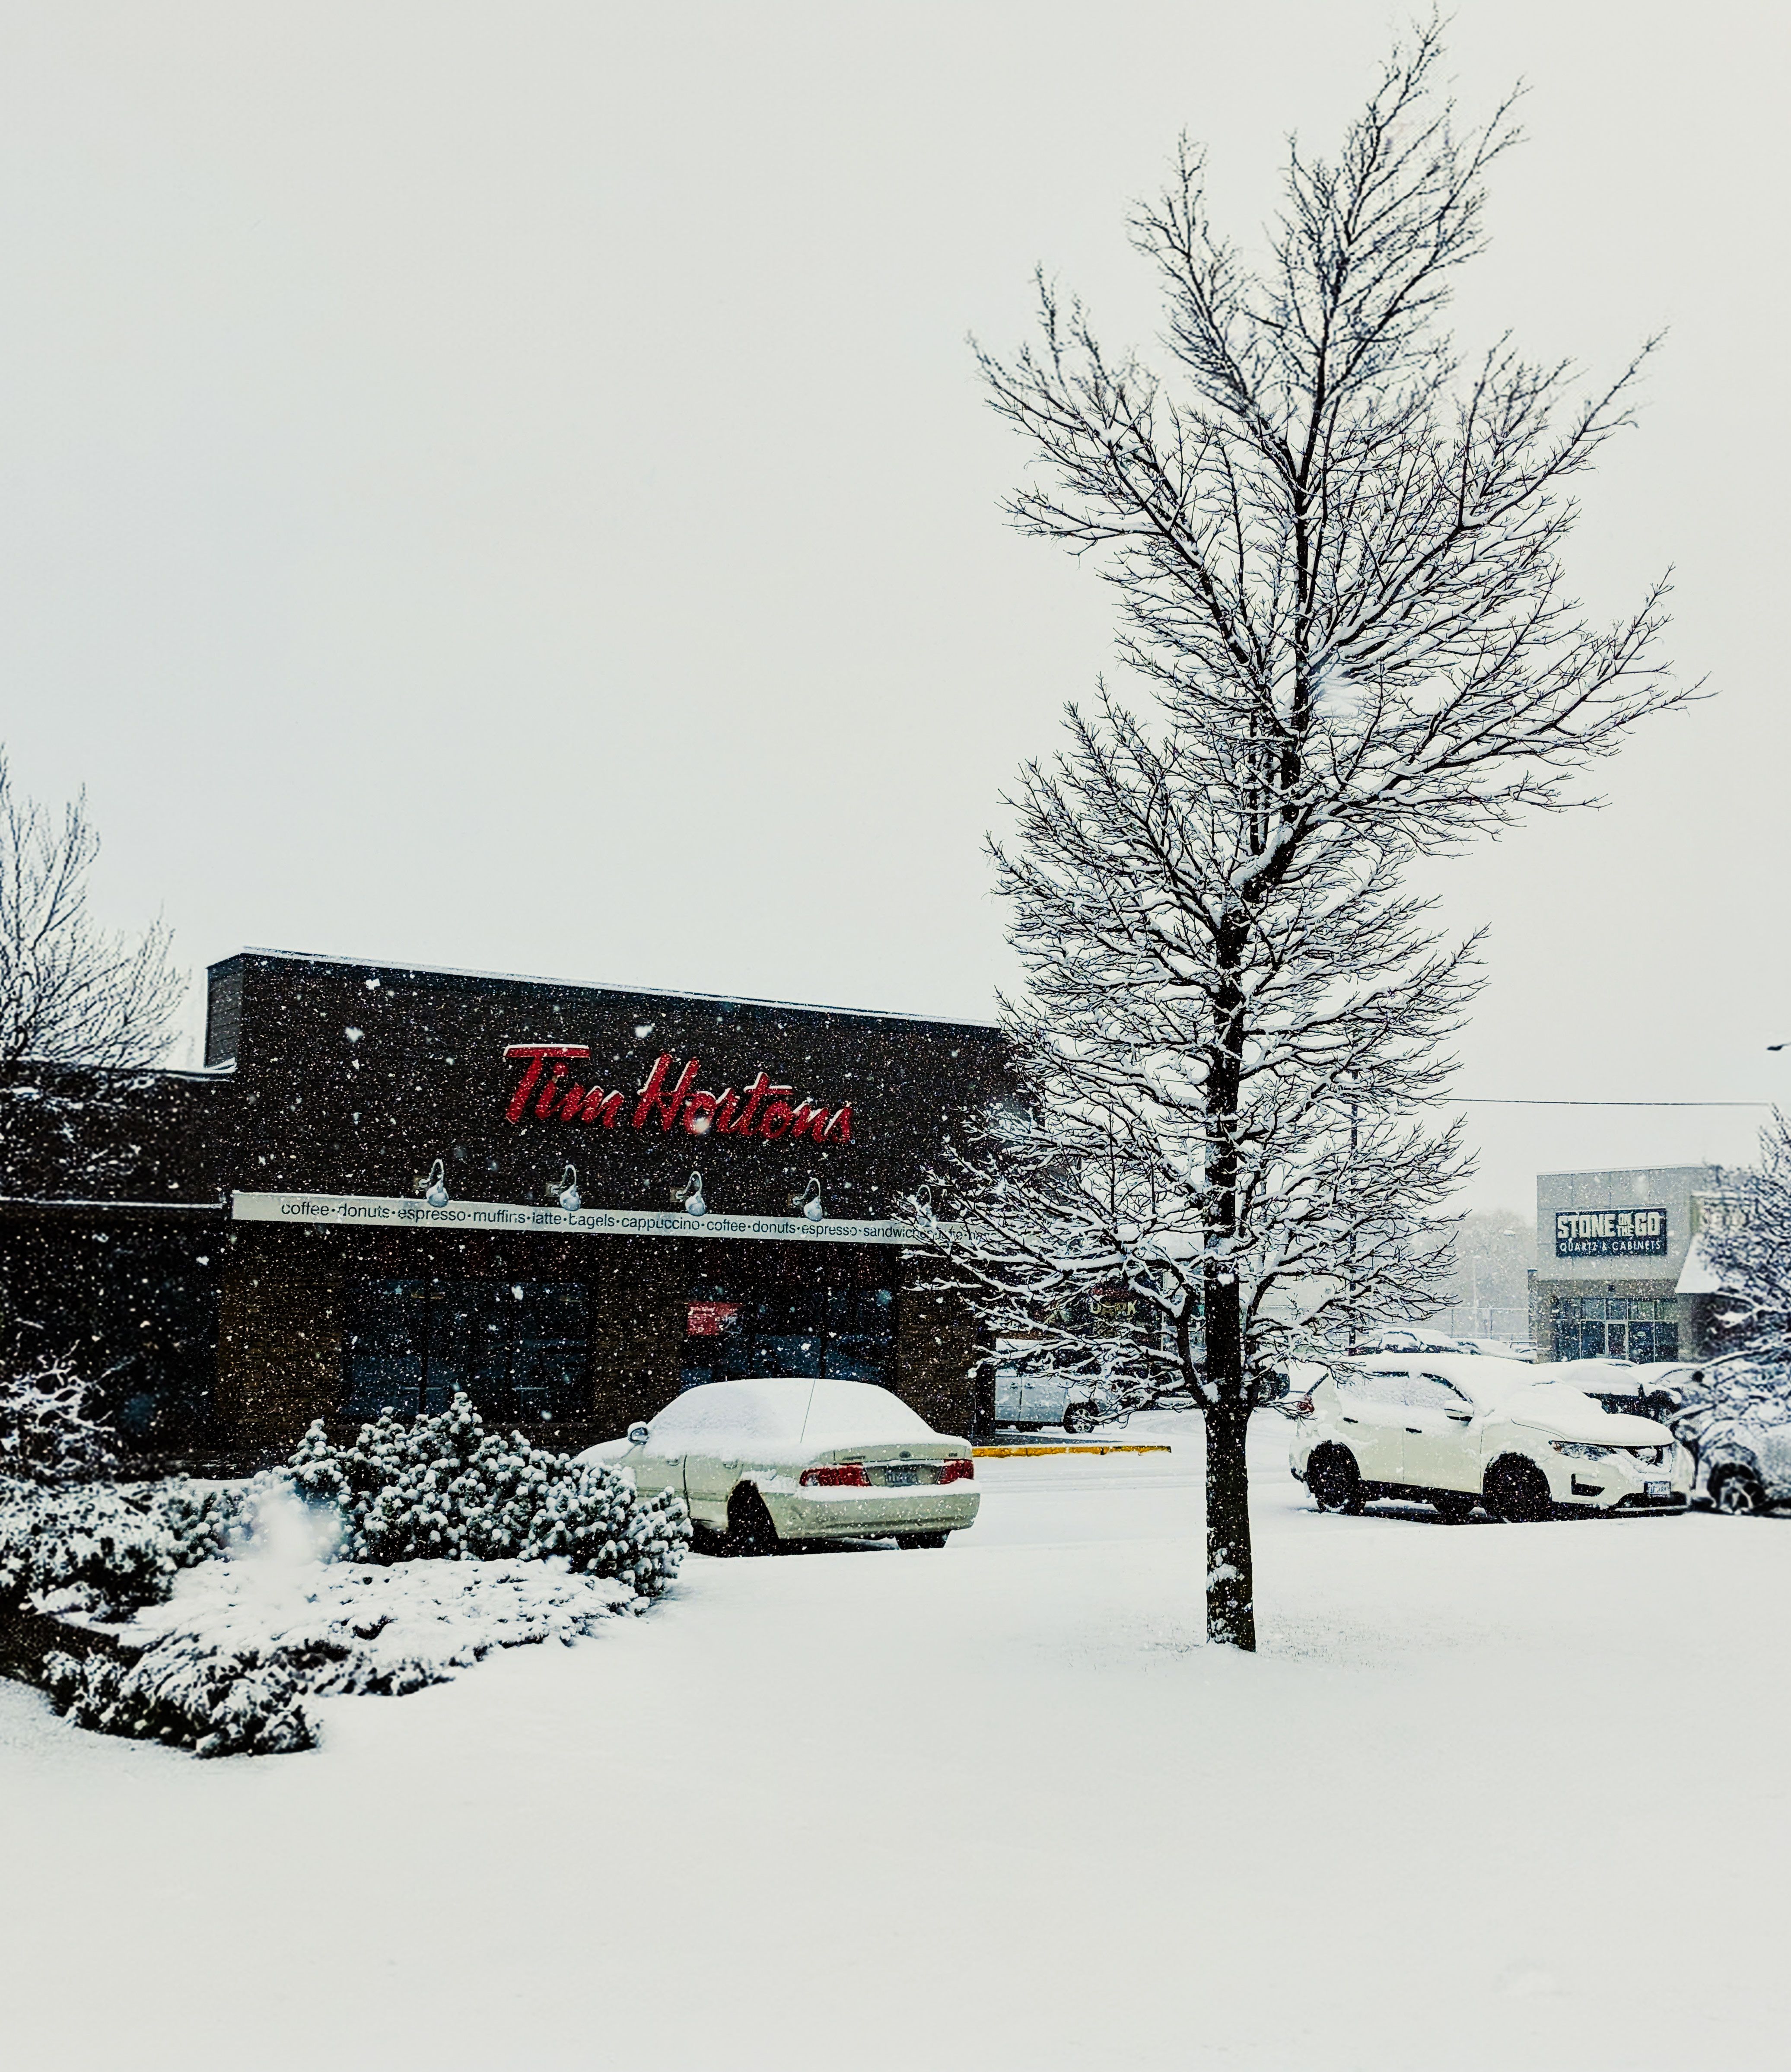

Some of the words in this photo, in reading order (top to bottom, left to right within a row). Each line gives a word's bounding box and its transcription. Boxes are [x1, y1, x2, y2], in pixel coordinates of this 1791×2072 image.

[503, 1044, 624, 1127] Tim
[632, 1052, 853, 1143] Hortons
[281, 1202, 329, 1216] coffee
[338, 1203, 390, 1218] donuts
[398, 1209, 466, 1223] espresso
[474, 1209, 525, 1223] muffins
[532, 1212, 561, 1225] latte
[569, 1213, 614, 1229] bagels
[622, 1217, 700, 1231] cappuccino
[707, 1219, 746, 1232] coffee
[753, 1221, 795, 1233] donuts
[802, 1225, 857, 1237] espresso
[1557, 1214, 1616, 1238] STONE
[1616, 1225, 1635, 1237] THE
[1618, 1213, 1632, 1225] ON
[1635, 1212, 1660, 1236] GO
[1560, 1241, 1597, 1253] QUARTZ
[1602, 1241, 1609, 1251] &
[1612, 1240, 1661, 1251] CABINETS
